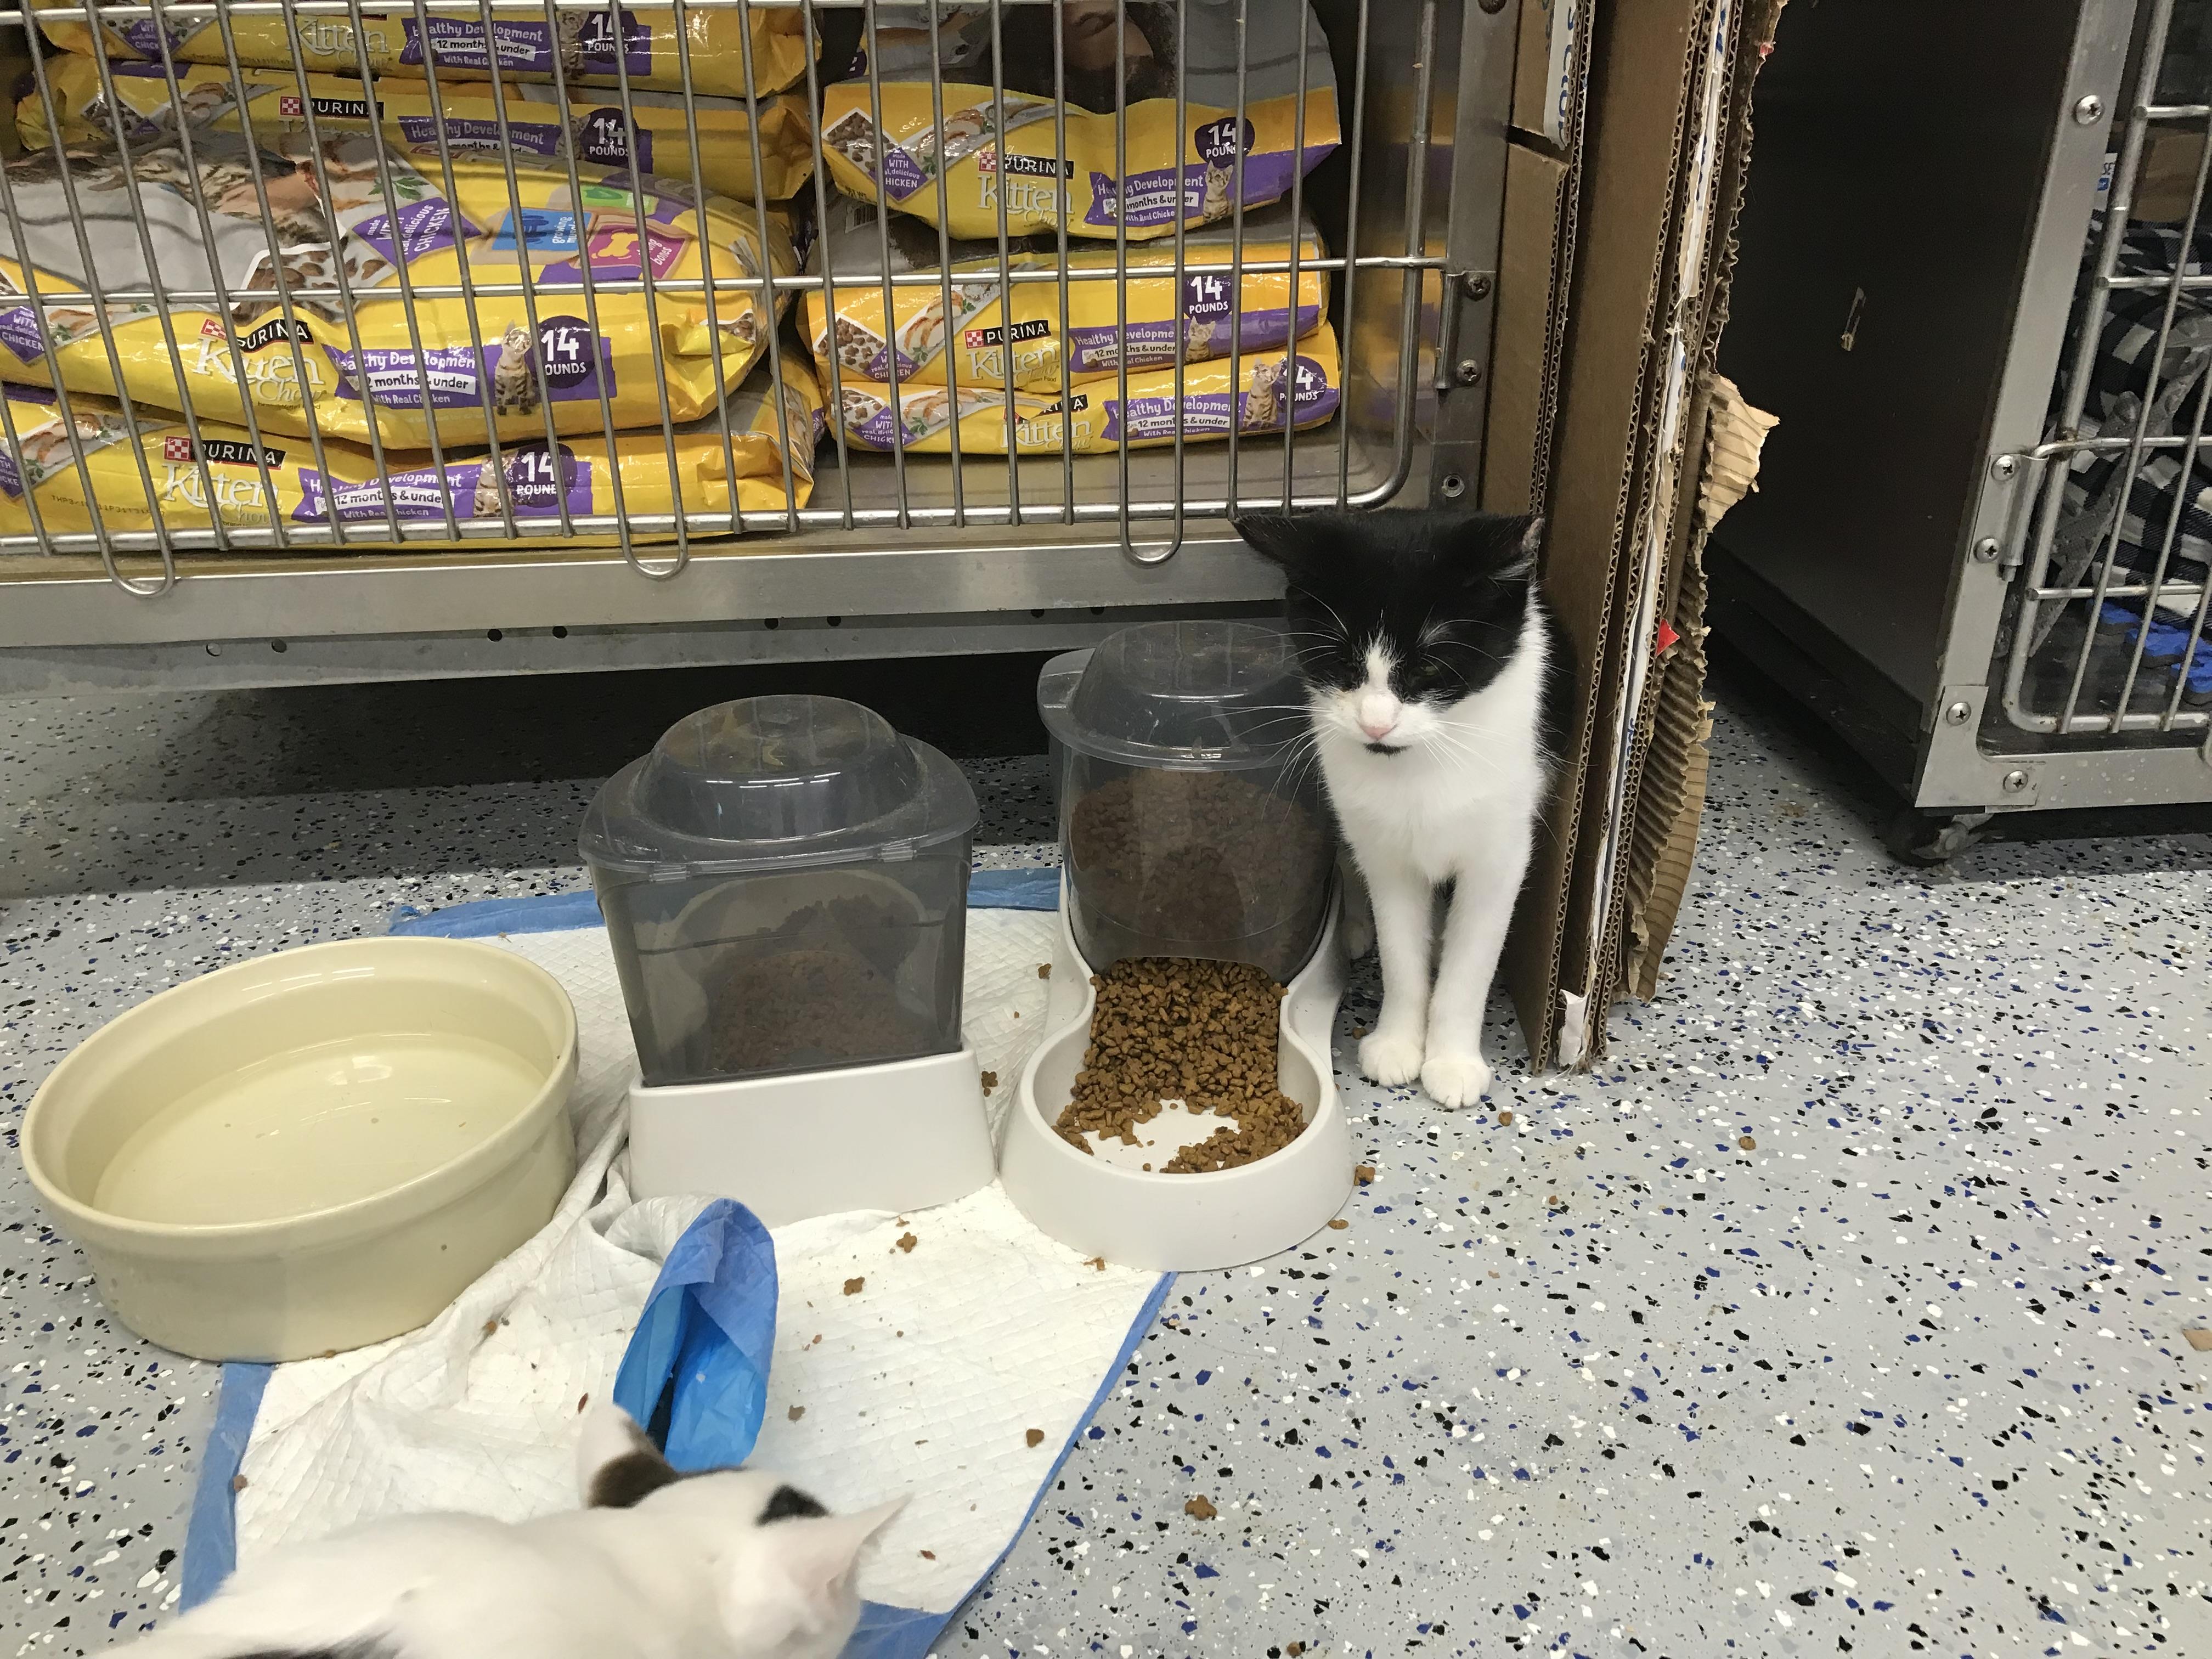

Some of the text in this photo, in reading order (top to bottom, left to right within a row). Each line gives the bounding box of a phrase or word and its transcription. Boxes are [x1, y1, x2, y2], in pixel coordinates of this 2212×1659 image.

[412, 23, 543, 42] Halthy Delopment
[437, 40, 530, 55] 12 month under
[588, 42, 629, 53] POUNS
[444, 55, 514, 66] With Real Cken
[311, 101, 372, 115] URIN
[412, 121, 545, 144] Heahy Develment
[592, 118, 627, 145] 14
[1206, 123, 1236, 159] 14 POUN
[889, 160, 909, 168] WITH
[885, 177, 918, 188] HICKEN
[1134, 175, 1204, 191] Developent
[1127, 194, 1158, 211] months
[1159, 195, 1167, 204] &
[1167, 195, 1194, 205] uner
[1153, 209, 1176, 219] Chicke
[368, 219, 381, 235] made
[414, 207, 450, 252] CHICKEN
[552, 217, 572, 244] growing
[650, 246, 672, 266] bones
[1189, 275, 1229, 314] 14 POUNDS
[2, 331, 44, 352] CHICKEN
[1075, 328, 1186, 346] Healthy evelopme
[541, 328, 587, 376] 14 OUNDS
[1095, 349, 1104, 358] 12
[1106, 345, 1140, 356] moths
[1150, 344, 1175, 352] under
[192, 336, 325, 385] Ktten
[340, 350, 476, 370] eathy Devlopmen
[1134, 356, 1163, 365] Chicken
[375, 373, 419, 388] months
[433, 377, 469, 390] under
[874, 369, 911, 379] CHIEN
[393, 394, 413, 404] Real
[414, 393, 451, 404] Cken
[1279, 390, 1318, 402] PUNDS
[1043, 398, 1084, 413] RIA
[1138, 416, 1228, 428] 12 monts & under
[1143, 429, 1161, 437] With
[202, 443, 277, 465] URINA
[370, 473, 462, 489] Dvelopmnt
[516, 452, 557, 496] 14 POUN
[335, 495, 348, 506] 12
[350, 490, 397, 504] monts
[401, 490, 409, 501] &
[411, 491, 443, 504] unde
[368, 509, 385, 517] Rea
[397, 509, 430, 517] hicken
